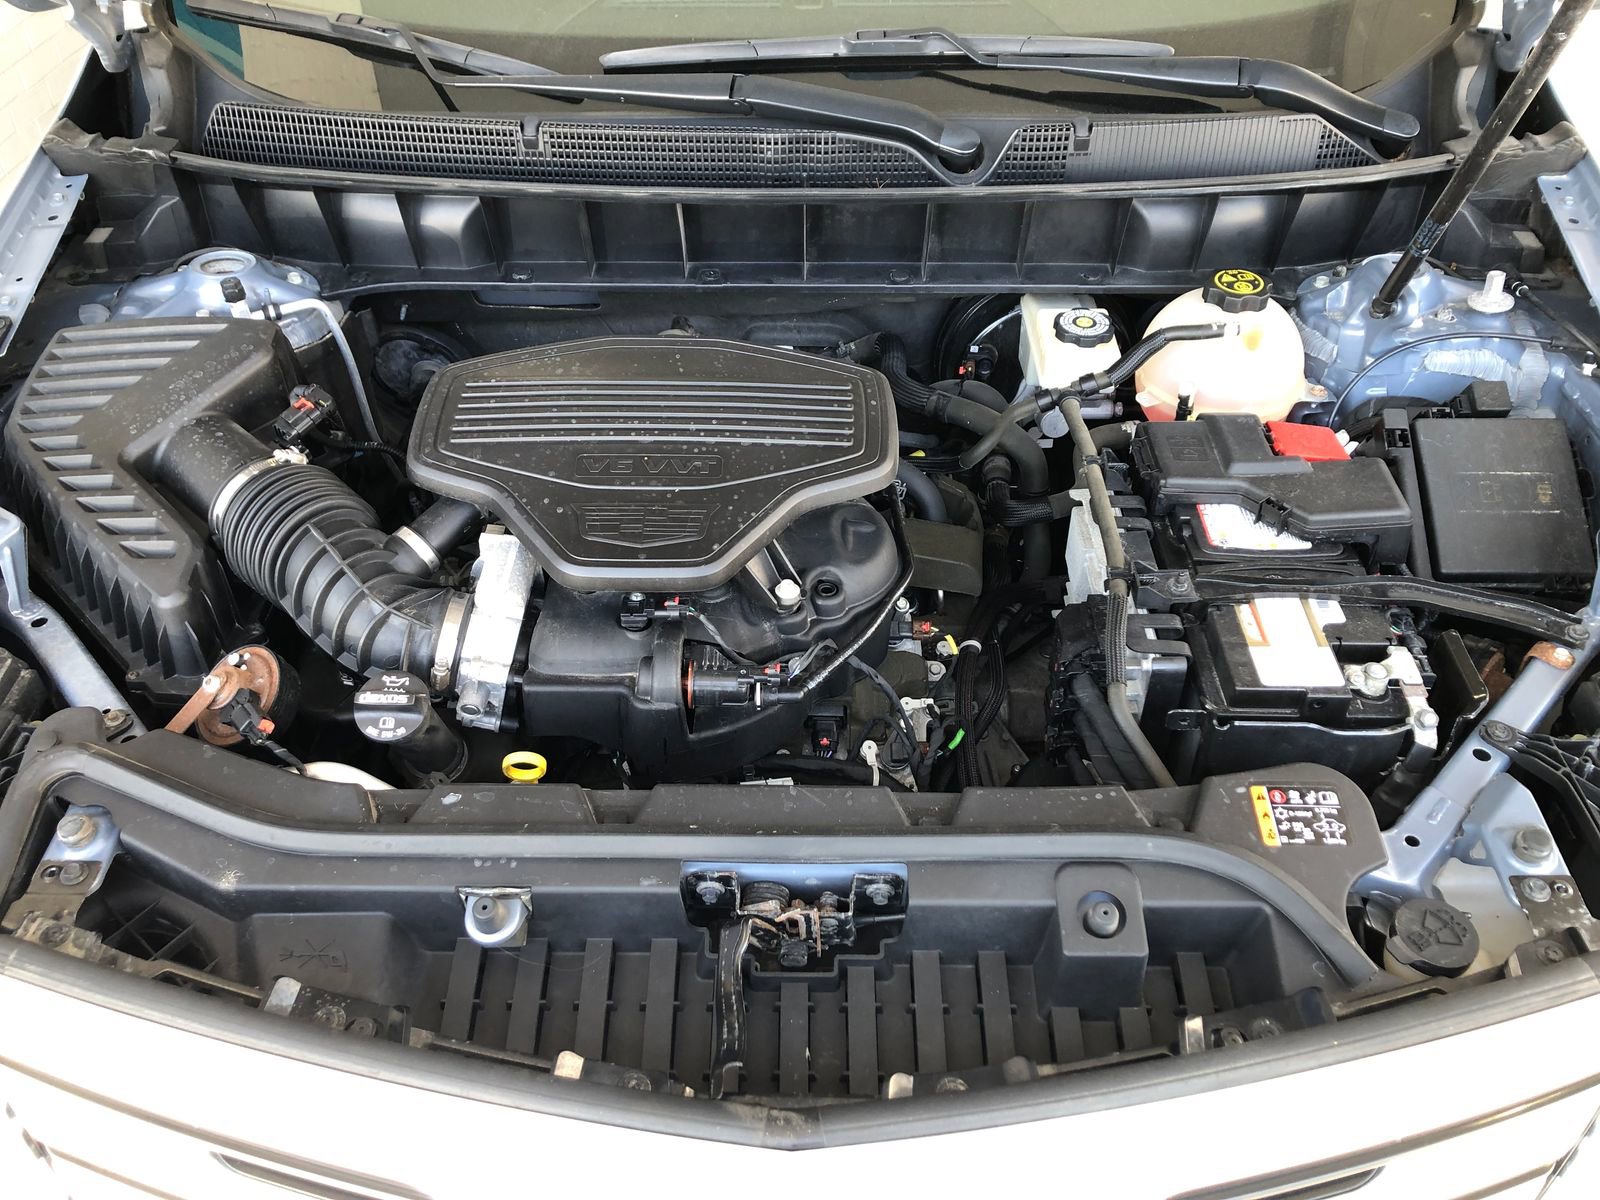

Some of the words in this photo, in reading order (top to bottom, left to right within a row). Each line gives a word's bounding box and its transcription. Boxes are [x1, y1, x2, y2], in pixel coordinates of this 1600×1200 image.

[583, 458, 633, 473] V6
[641, 458, 717, 474] VVT
[359, 692, 410, 703] dexos
